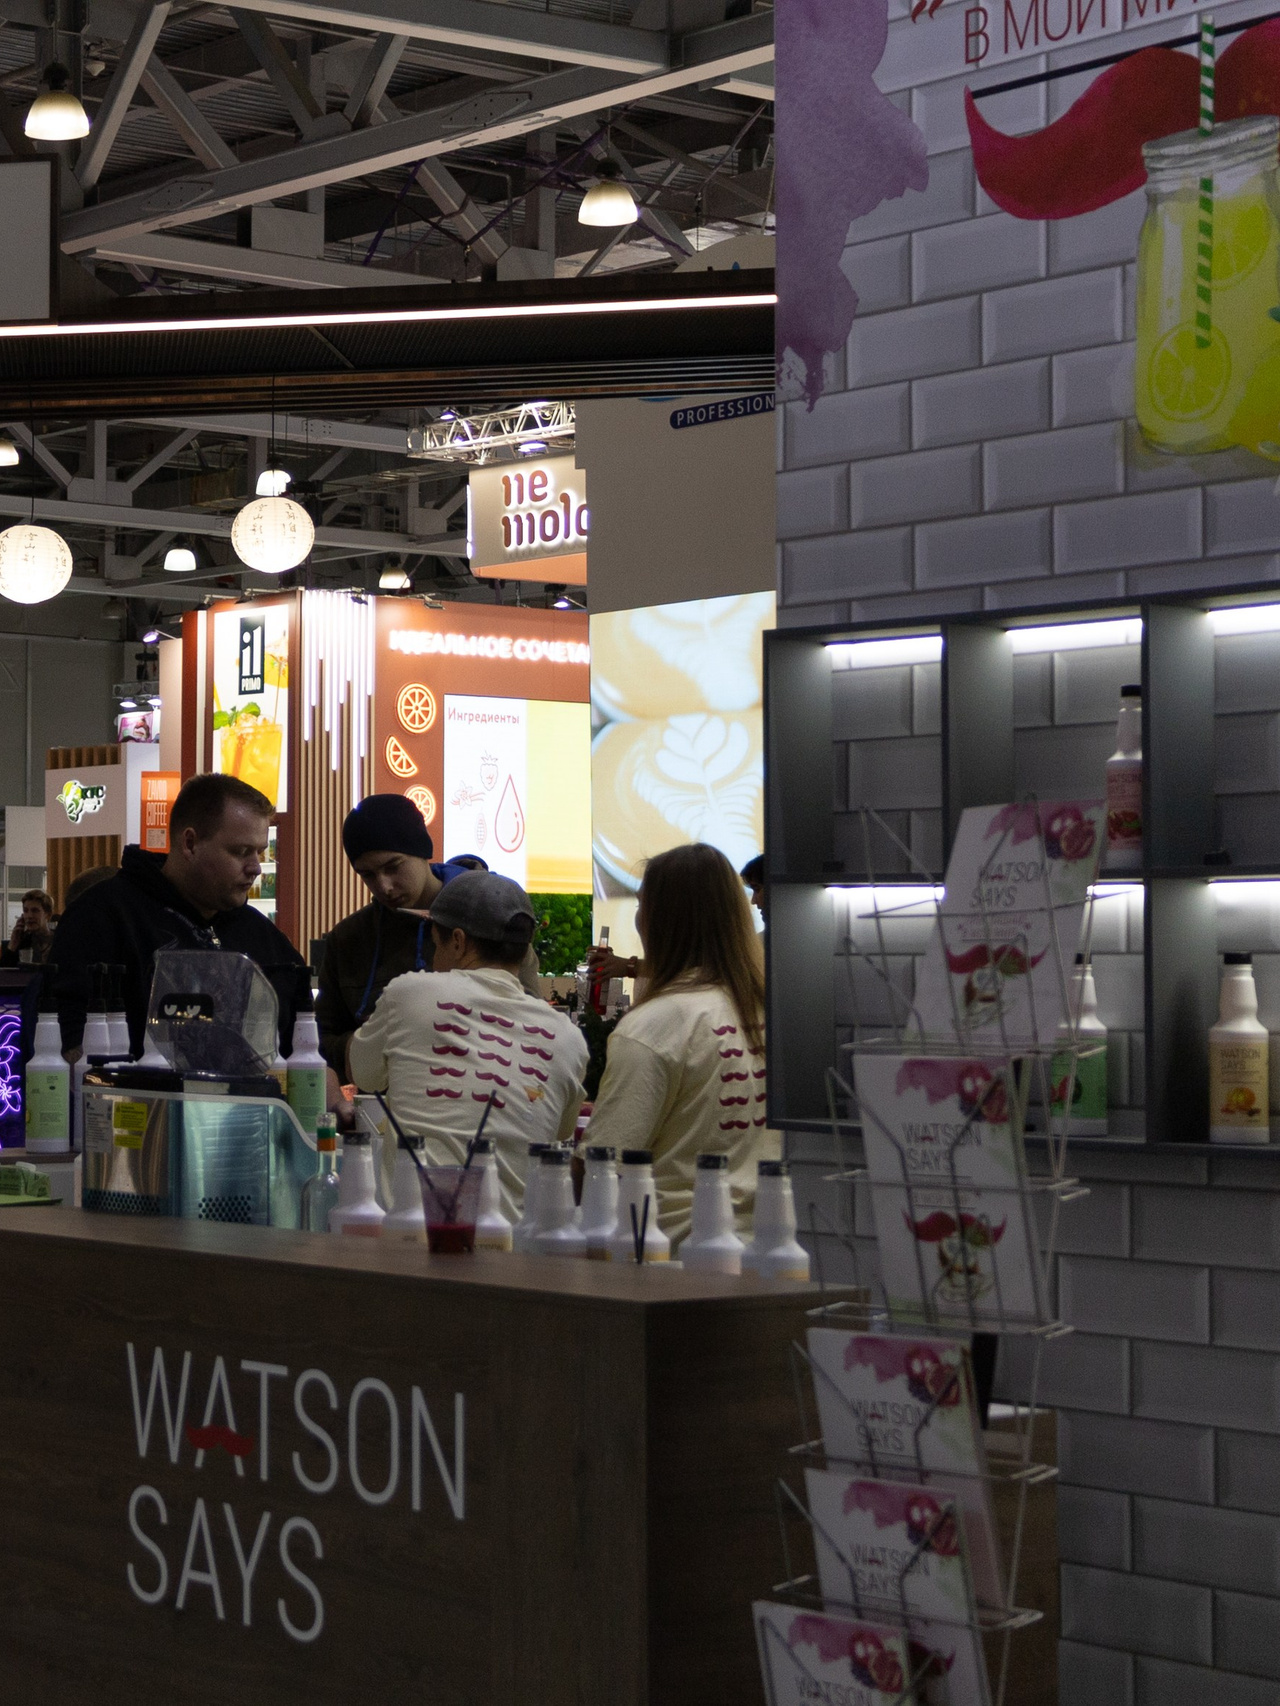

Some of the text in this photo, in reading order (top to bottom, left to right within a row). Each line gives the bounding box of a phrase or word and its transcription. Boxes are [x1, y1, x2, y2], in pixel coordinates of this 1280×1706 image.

[964, 7, 990, 64] В
[389, 629, 513, 659] ИДЕАЛЬНОЕ
[241, 677, 262, 692] PRIMO
[448, 706, 520, 725] Ингредиенты
[146, 802, 168, 826] COFFEE
[126, 1342, 466, 1521] WATSON
[127, 1484, 325, 1642] SAYS
